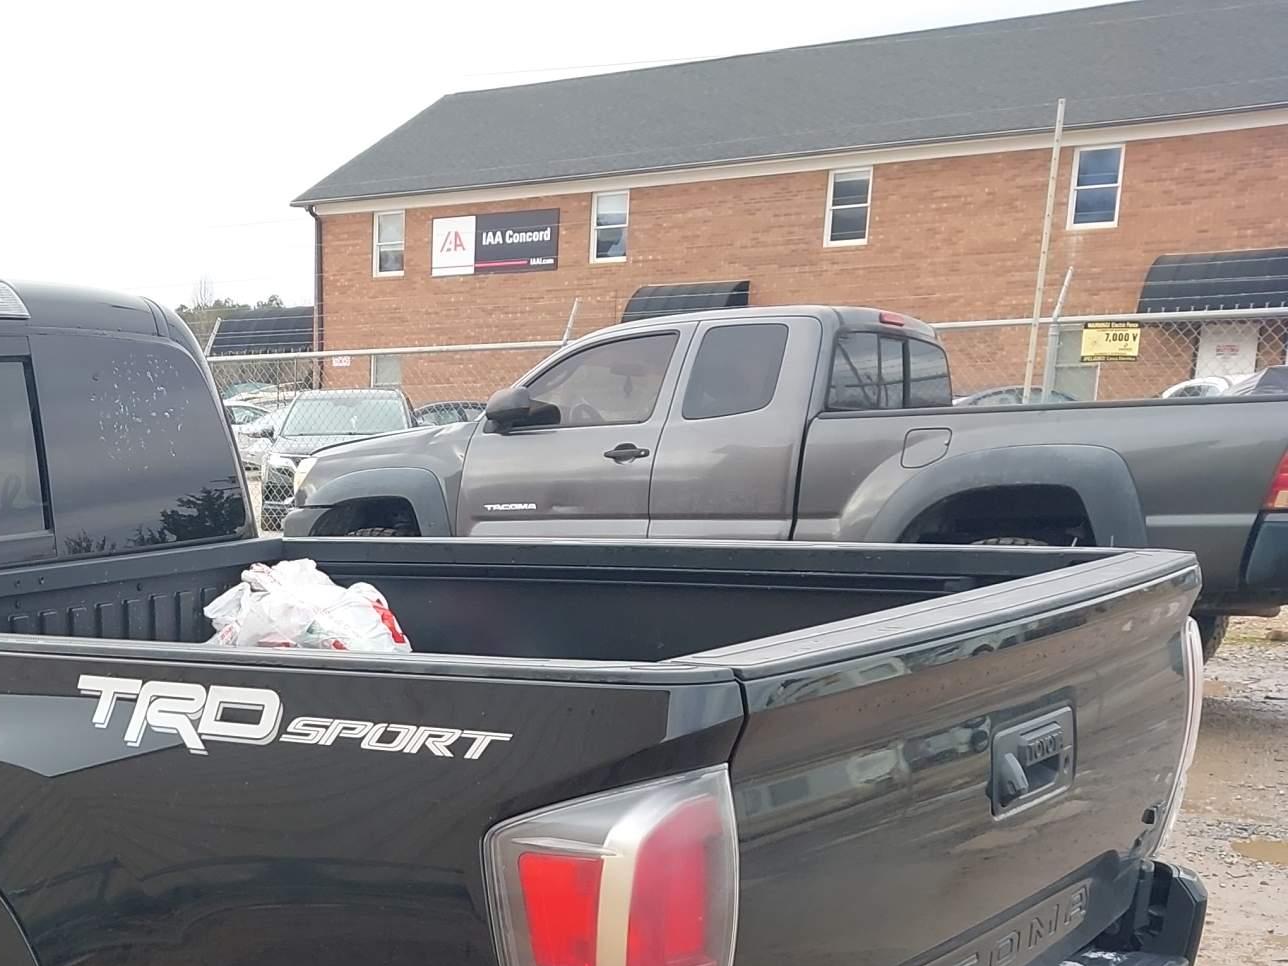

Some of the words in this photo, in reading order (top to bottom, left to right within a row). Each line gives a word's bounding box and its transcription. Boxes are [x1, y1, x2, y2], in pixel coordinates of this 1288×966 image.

[482, 230, 503, 245] IAA
[505, 227, 551, 244] Concord
[1105, 333, 1130, 342] 7,000
[1132, 333, 1138, 342] V
[483, 503, 537, 511] TACOMA
[78, 674, 285, 756] TRD
[279, 716, 513, 760] SPORT
